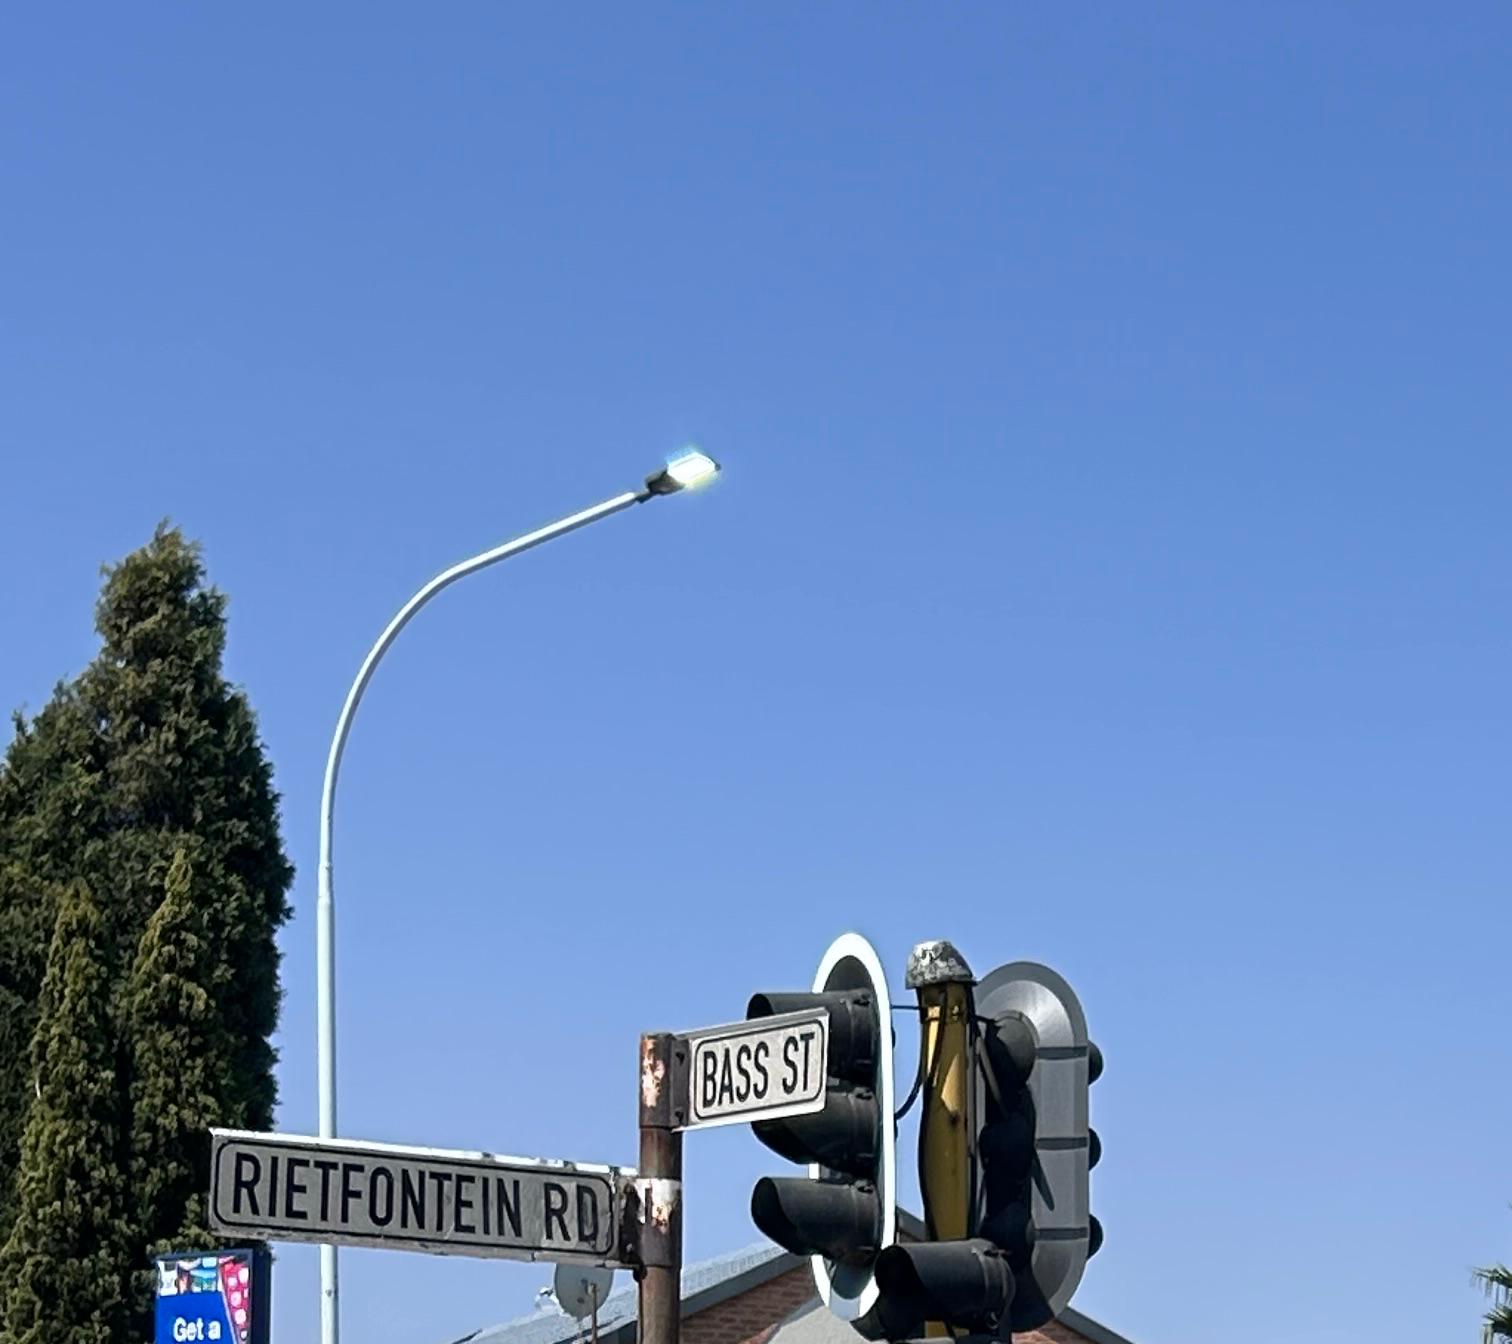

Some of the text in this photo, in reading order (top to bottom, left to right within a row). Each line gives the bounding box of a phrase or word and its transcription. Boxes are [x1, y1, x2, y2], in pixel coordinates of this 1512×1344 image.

[702, 1032, 815, 1109] BASS ST
[233, 1151, 600, 1242] RIETFONTEIN RD
[174, 1317, 221, 1342] Get a
